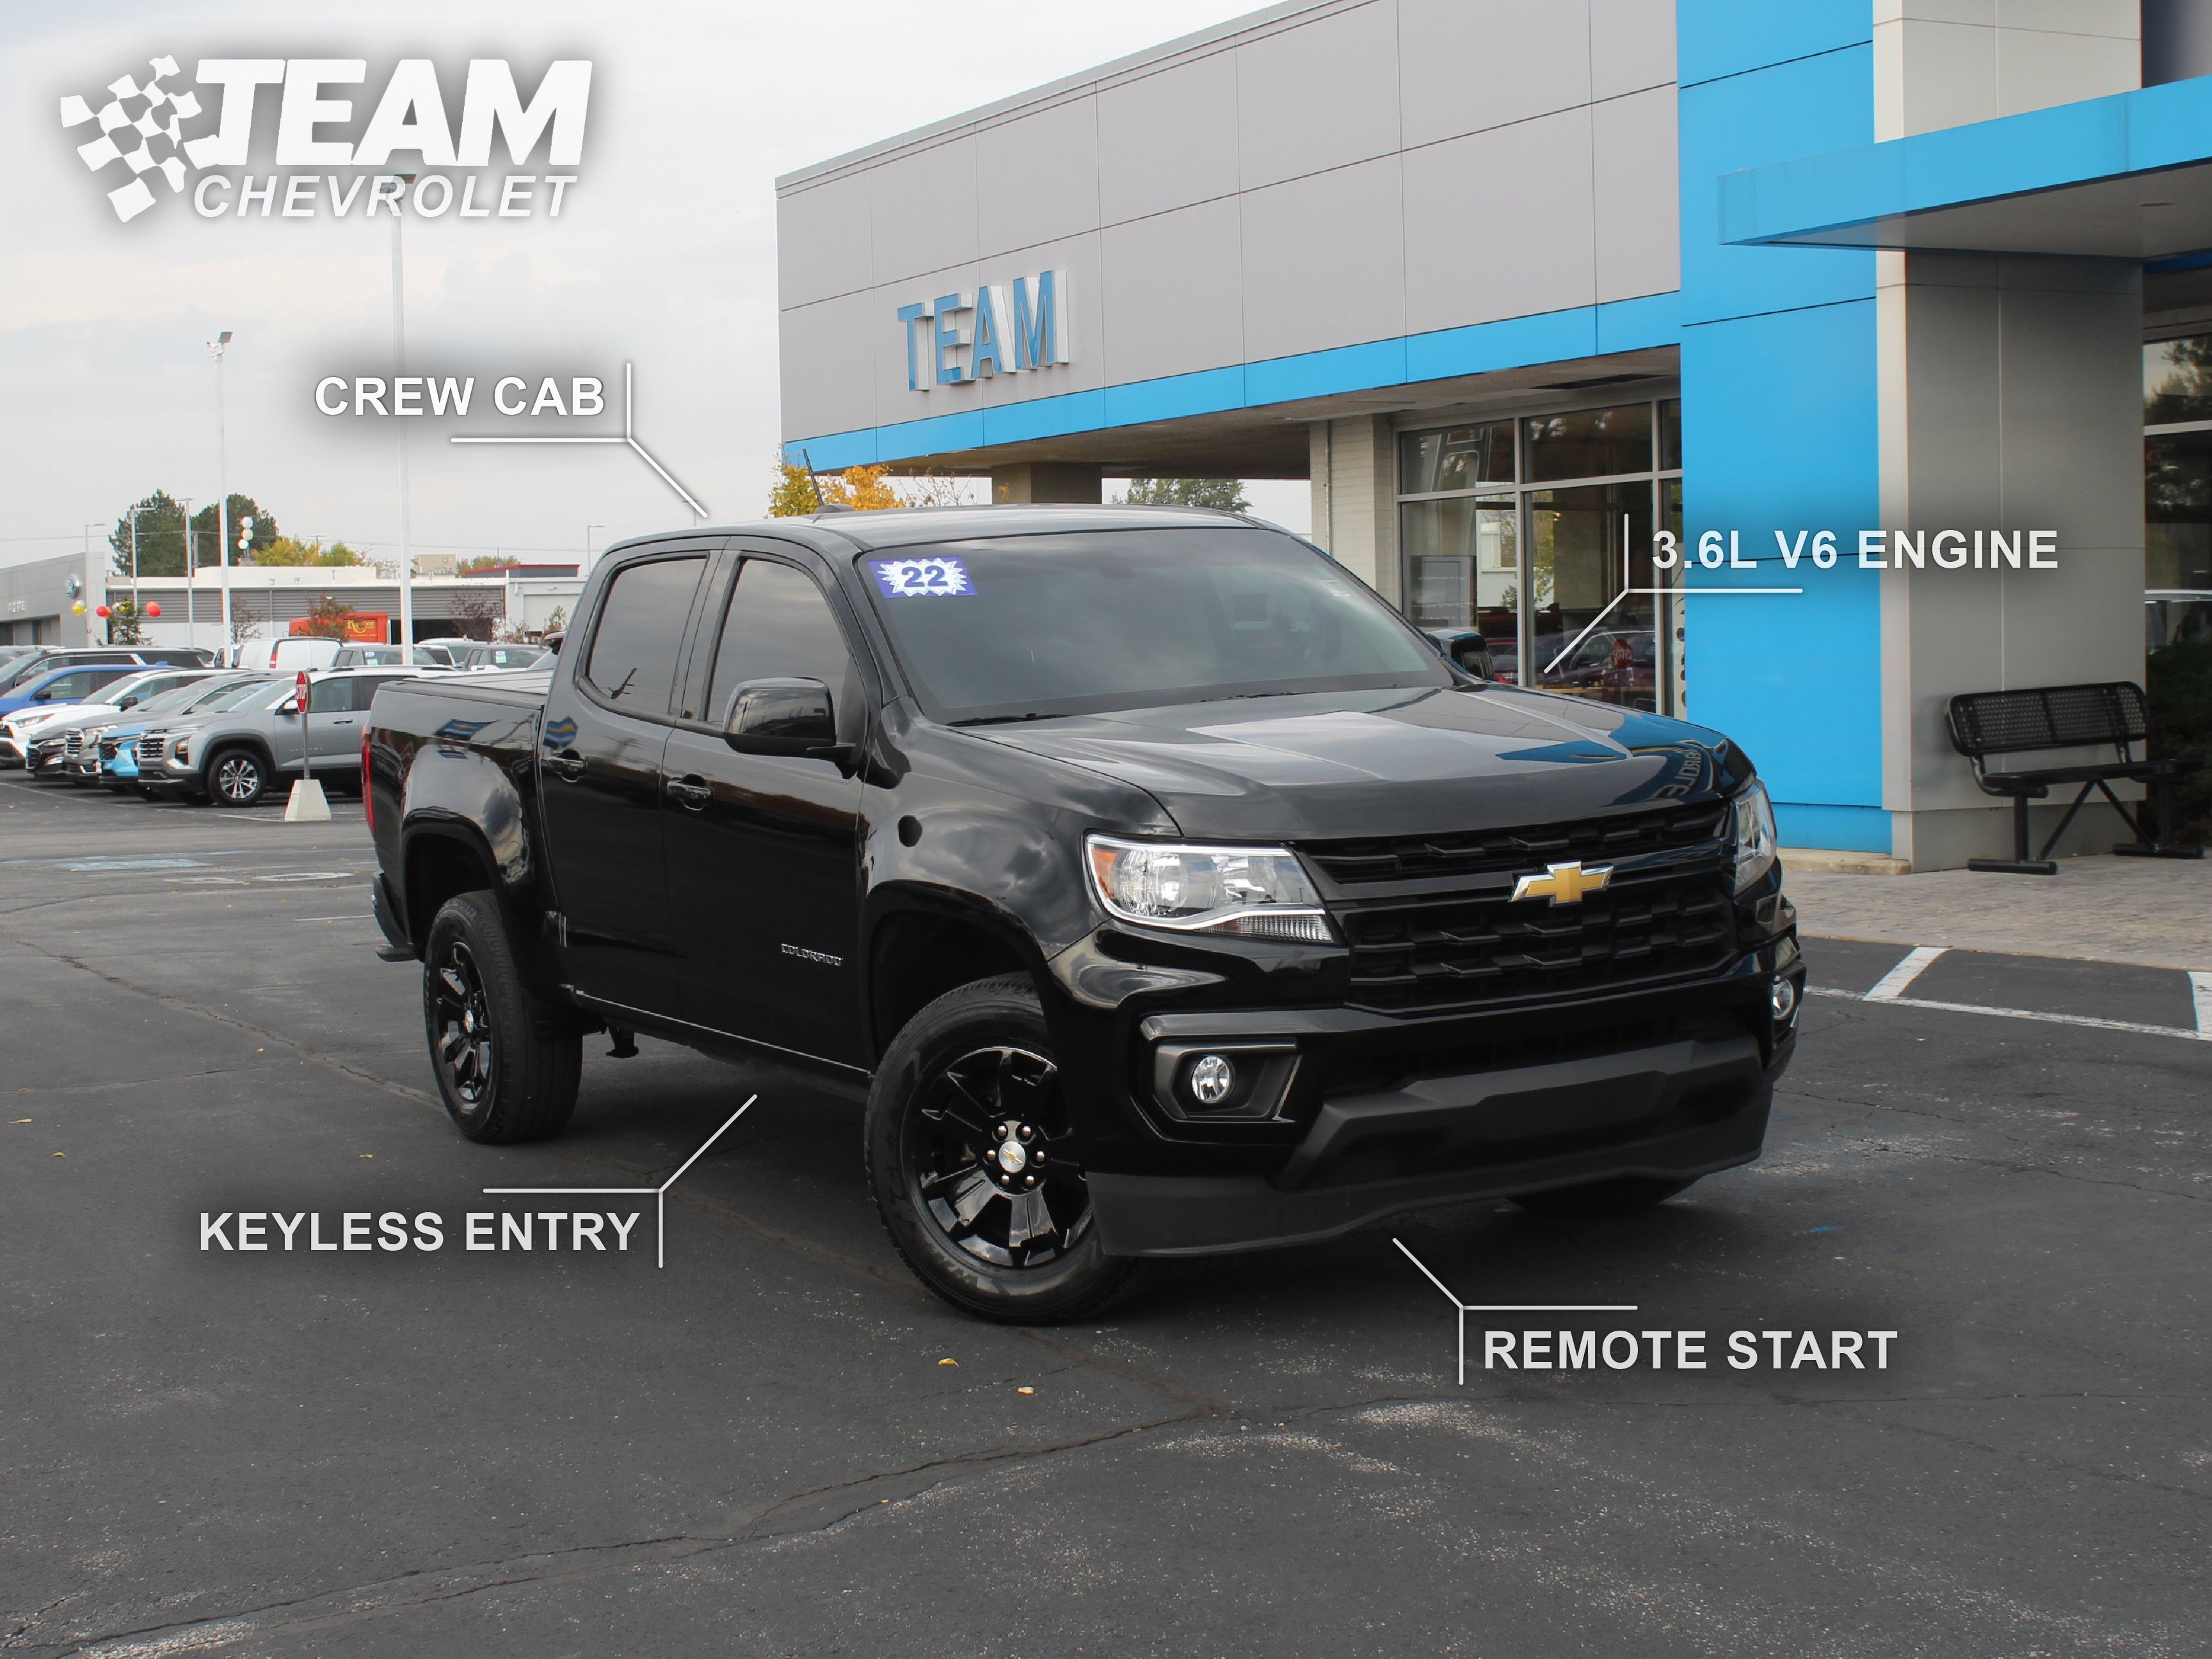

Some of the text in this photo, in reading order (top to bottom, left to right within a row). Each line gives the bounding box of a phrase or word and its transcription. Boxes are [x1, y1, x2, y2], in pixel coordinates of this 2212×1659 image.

[897, 269, 1069, 391] TEAM
[901, 565, 948, 588] 22
[296, 683, 307, 700] STOP
[781, 943, 844, 966] COLORADO
